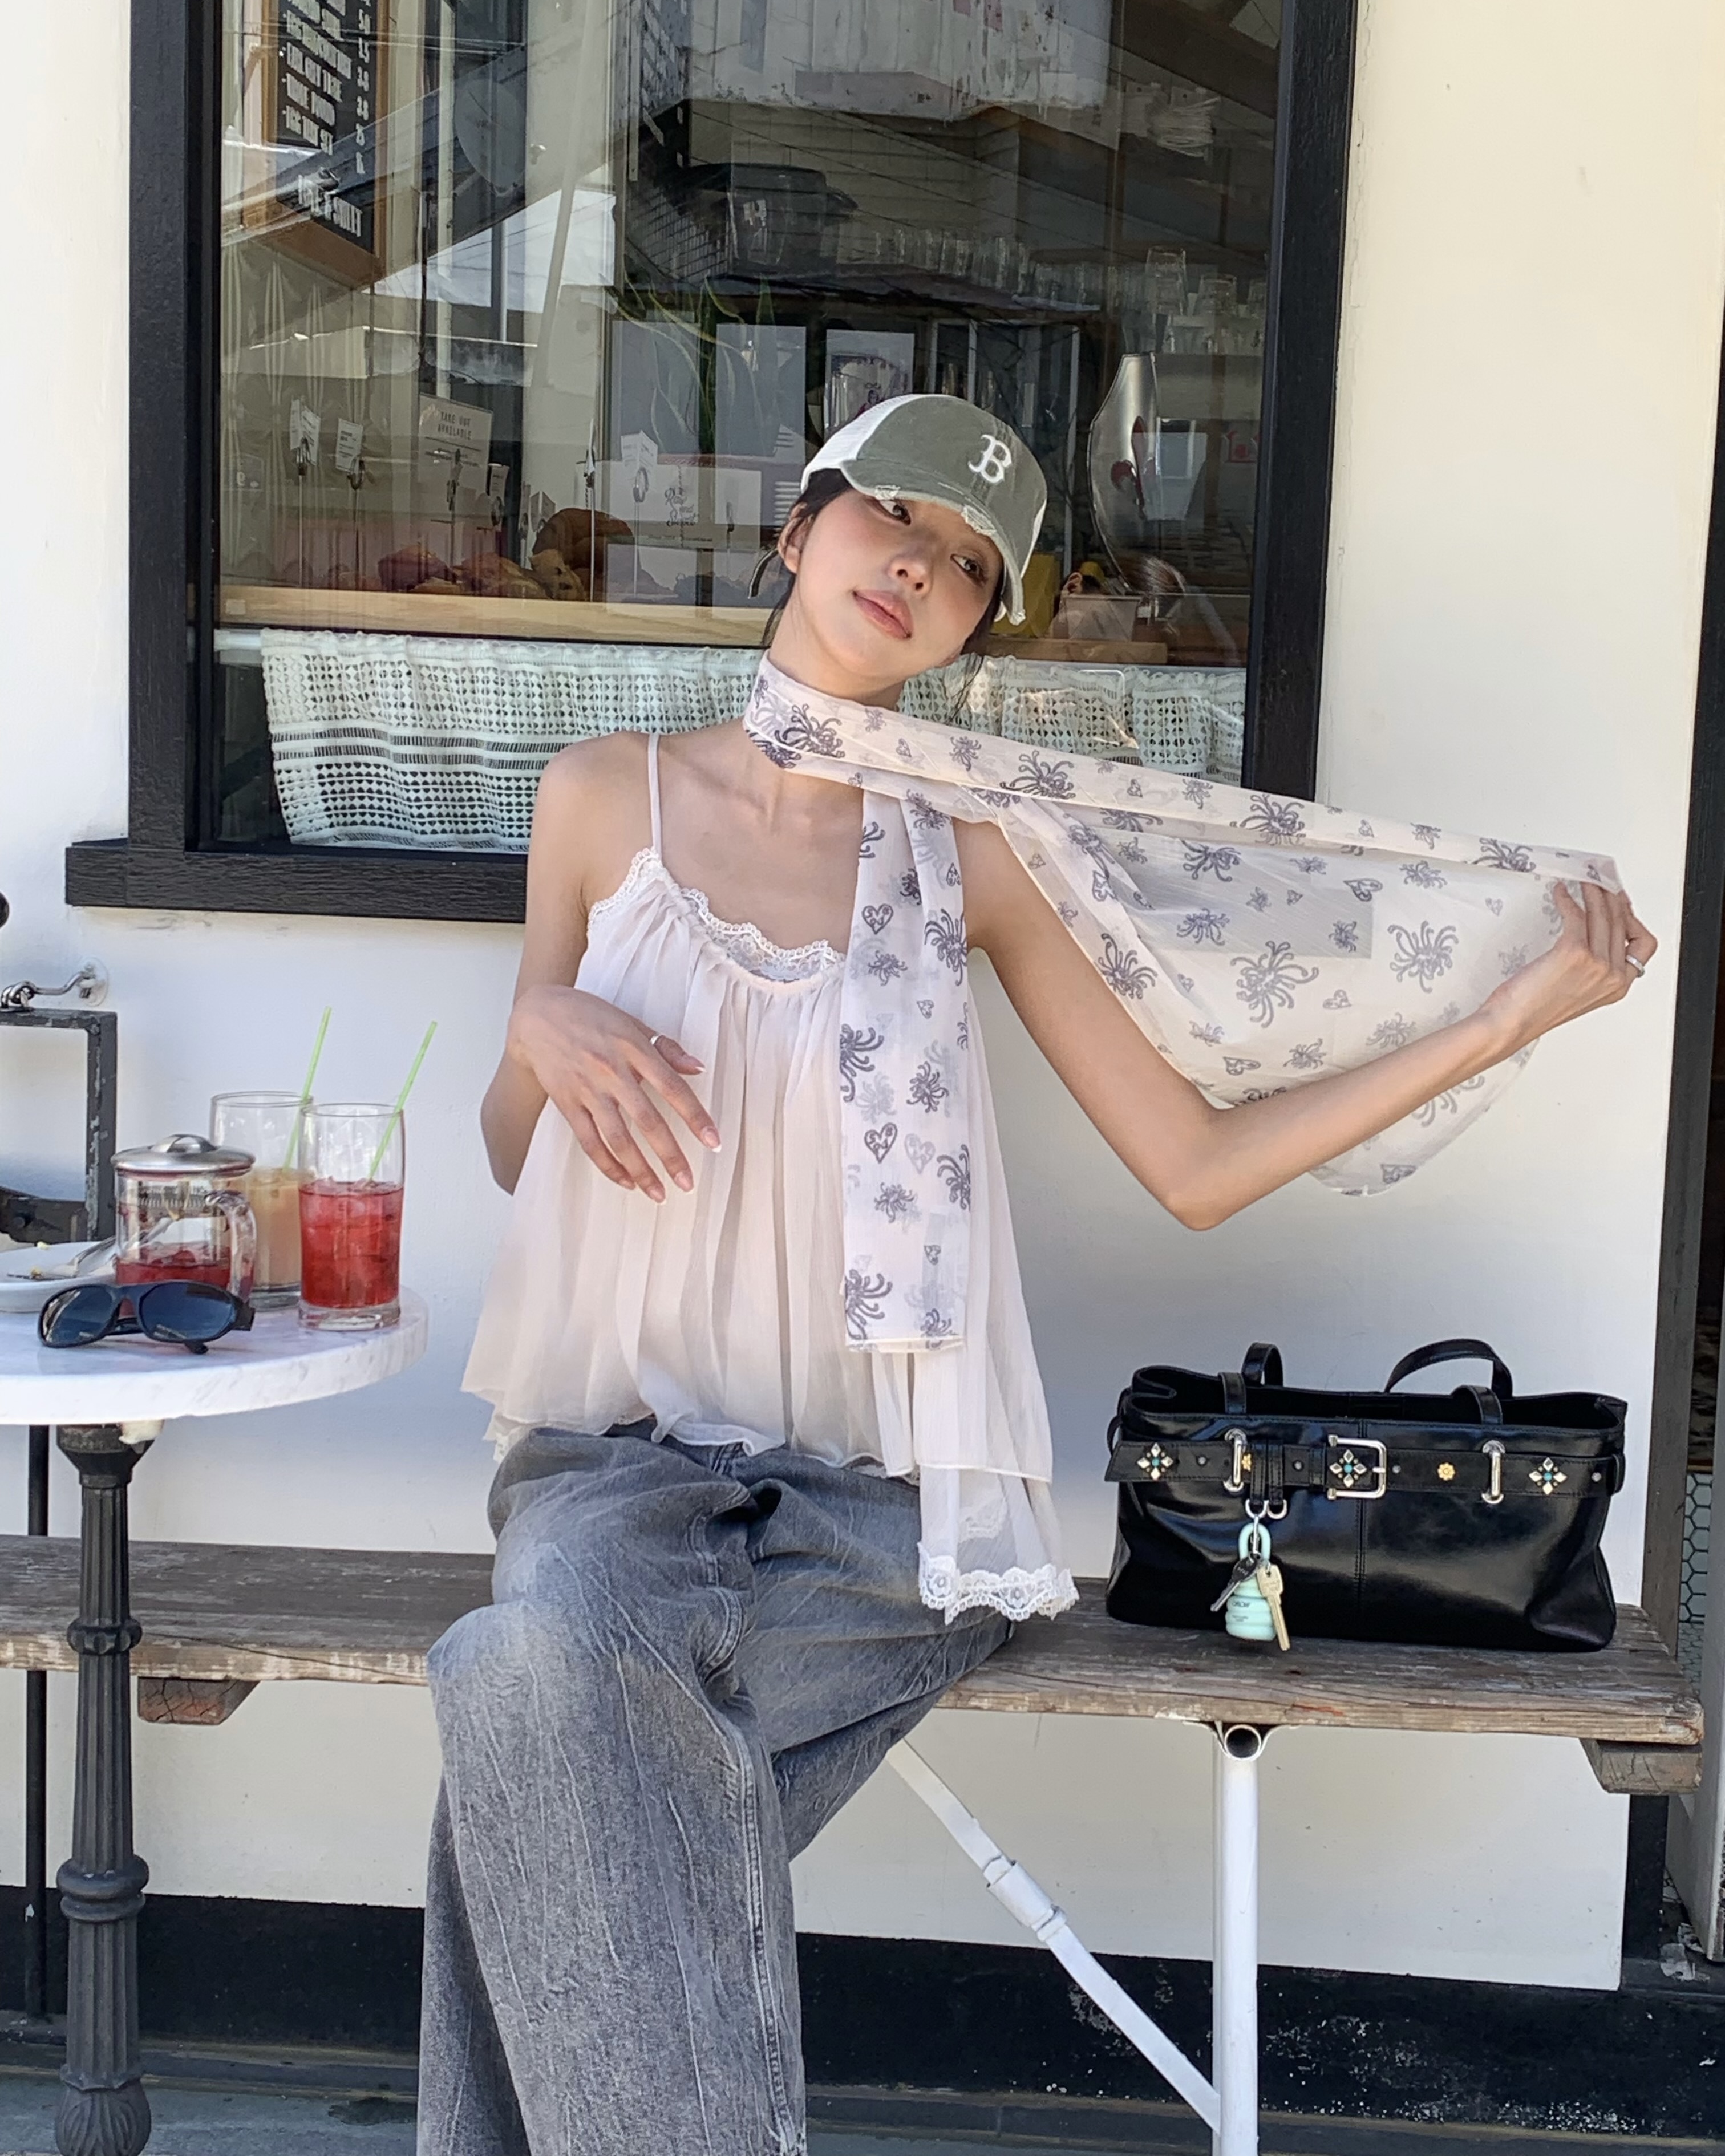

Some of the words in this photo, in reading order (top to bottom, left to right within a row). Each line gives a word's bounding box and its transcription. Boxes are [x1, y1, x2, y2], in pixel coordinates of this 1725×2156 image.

[440, 411, 455, 424] TAKE
[459, 416, 471, 427] OUT
[438, 423, 472, 441] AVAILABLE
[967, 434, 1011, 483] B
